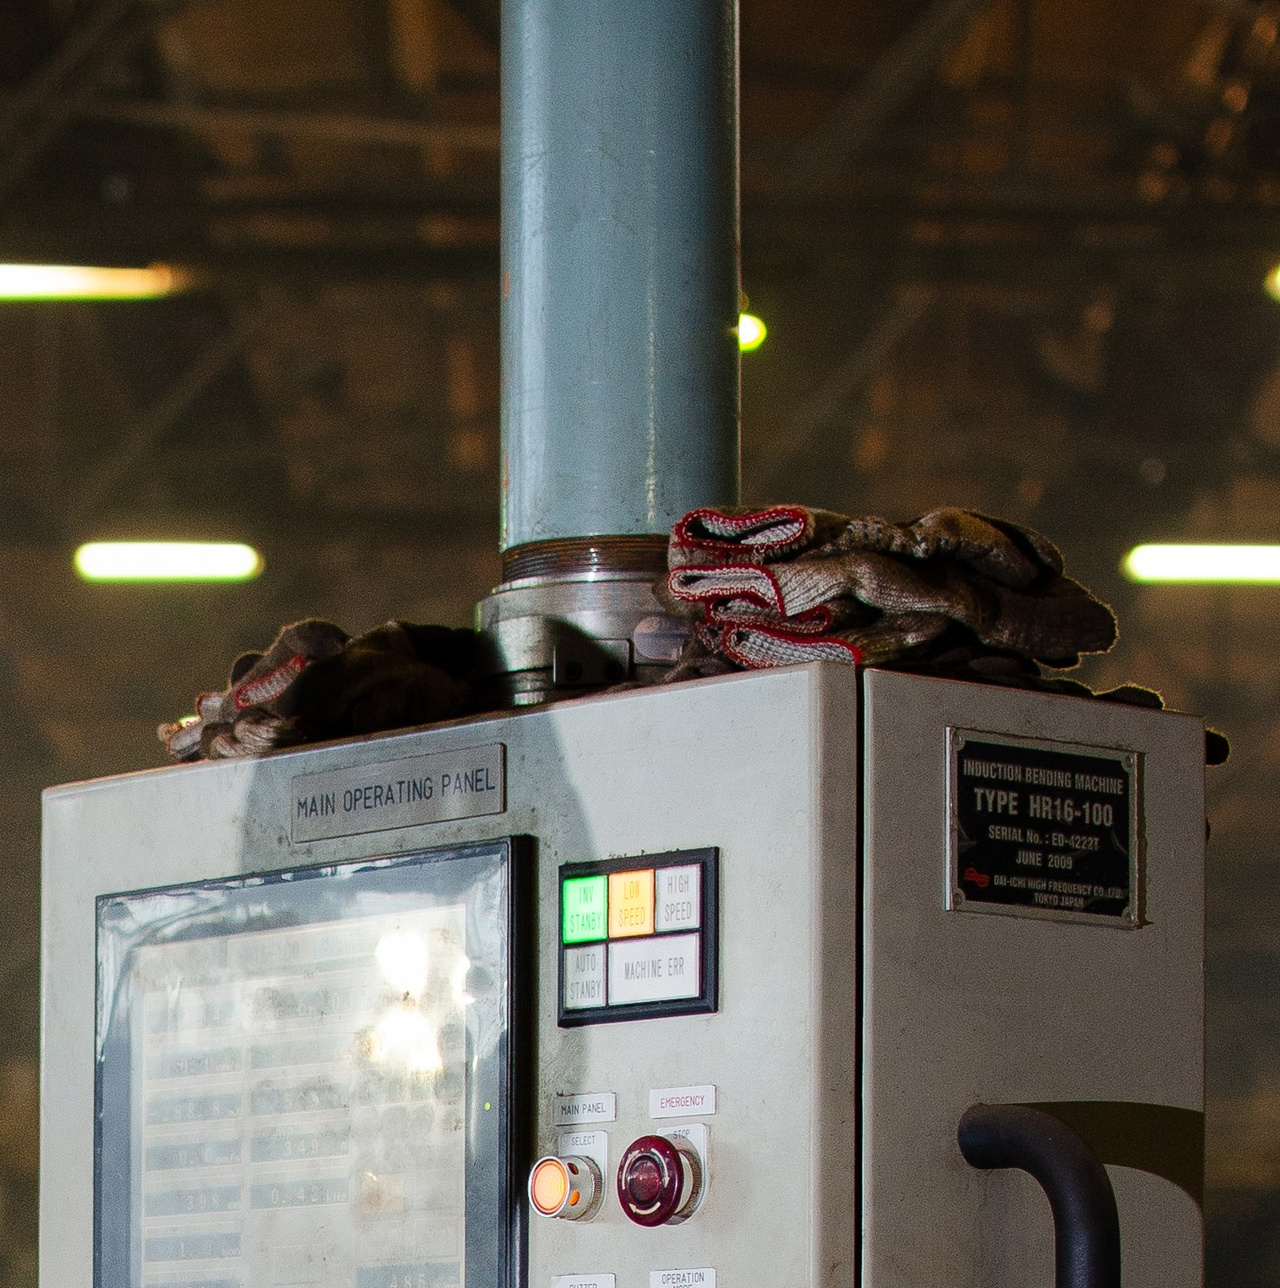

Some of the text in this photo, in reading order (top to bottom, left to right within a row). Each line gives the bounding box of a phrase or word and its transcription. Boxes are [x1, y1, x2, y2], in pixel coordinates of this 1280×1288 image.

[963, 759, 1123, 795] INDUCTION BENDING MACHINE
[297, 768, 495, 818] MAIN OPERATING PANEL
[974, 788, 1114, 827] TYPE HR16-100
[988, 825, 1023, 842] SERIAL
[1026, 830, 1043, 845] No.
[1016, 851, 1073, 870] JUNE 2009
[624, 880, 640, 900] LOW
[667, 874, 689, 894] HIGH
[994, 875, 1026, 888] DAI-ICHI
[1028, 878, 1047, 891] HIGH
[1048, 881, 1091, 895] FREQUENCY
[579, 885, 594, 904] INV
[1034, 892, 1084, 908] TOKYO JAPAN
[619, 906, 645, 927] SPEED
[665, 901, 691, 922] SPEED
[570, 912, 602, 933] STANBY
[575, 953, 596, 973] AUTO
[624, 957, 685, 981] MACHINE ERR
[570, 979, 602, 1000] STANBY
[560, 1103, 606, 1116] MAIN PANEL
[660, 1095, 705, 1109] EMERGENCY
[571, 1135, 596, 1146] SELECT
[672, 1129, 691, 1140] STOP
[661, 1272, 705, 1284] OPERATION
